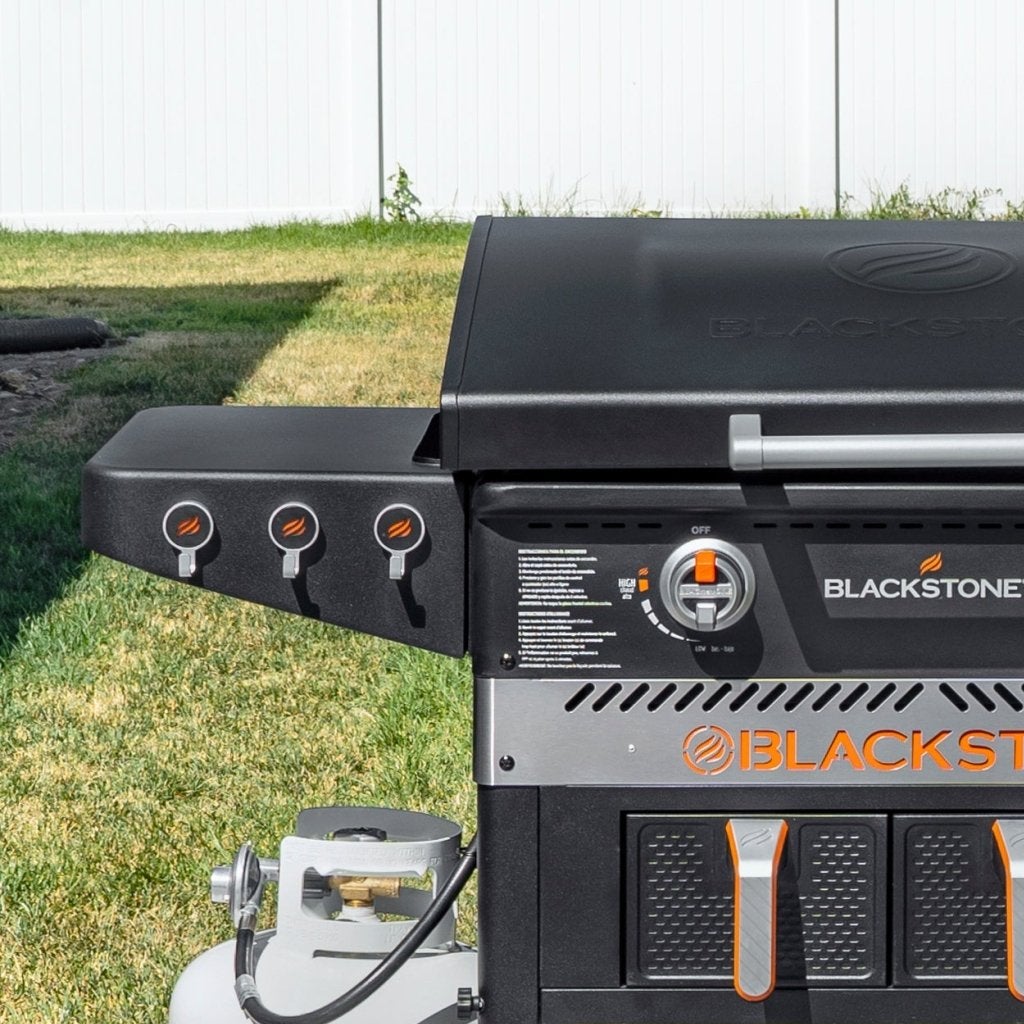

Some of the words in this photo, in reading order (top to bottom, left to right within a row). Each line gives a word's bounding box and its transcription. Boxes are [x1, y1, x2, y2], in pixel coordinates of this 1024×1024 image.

[691, 526, 711, 534] OFF
[618, 578, 636, 588] HIGH
[824, 578, 1023, 599] BLACKSTONE
